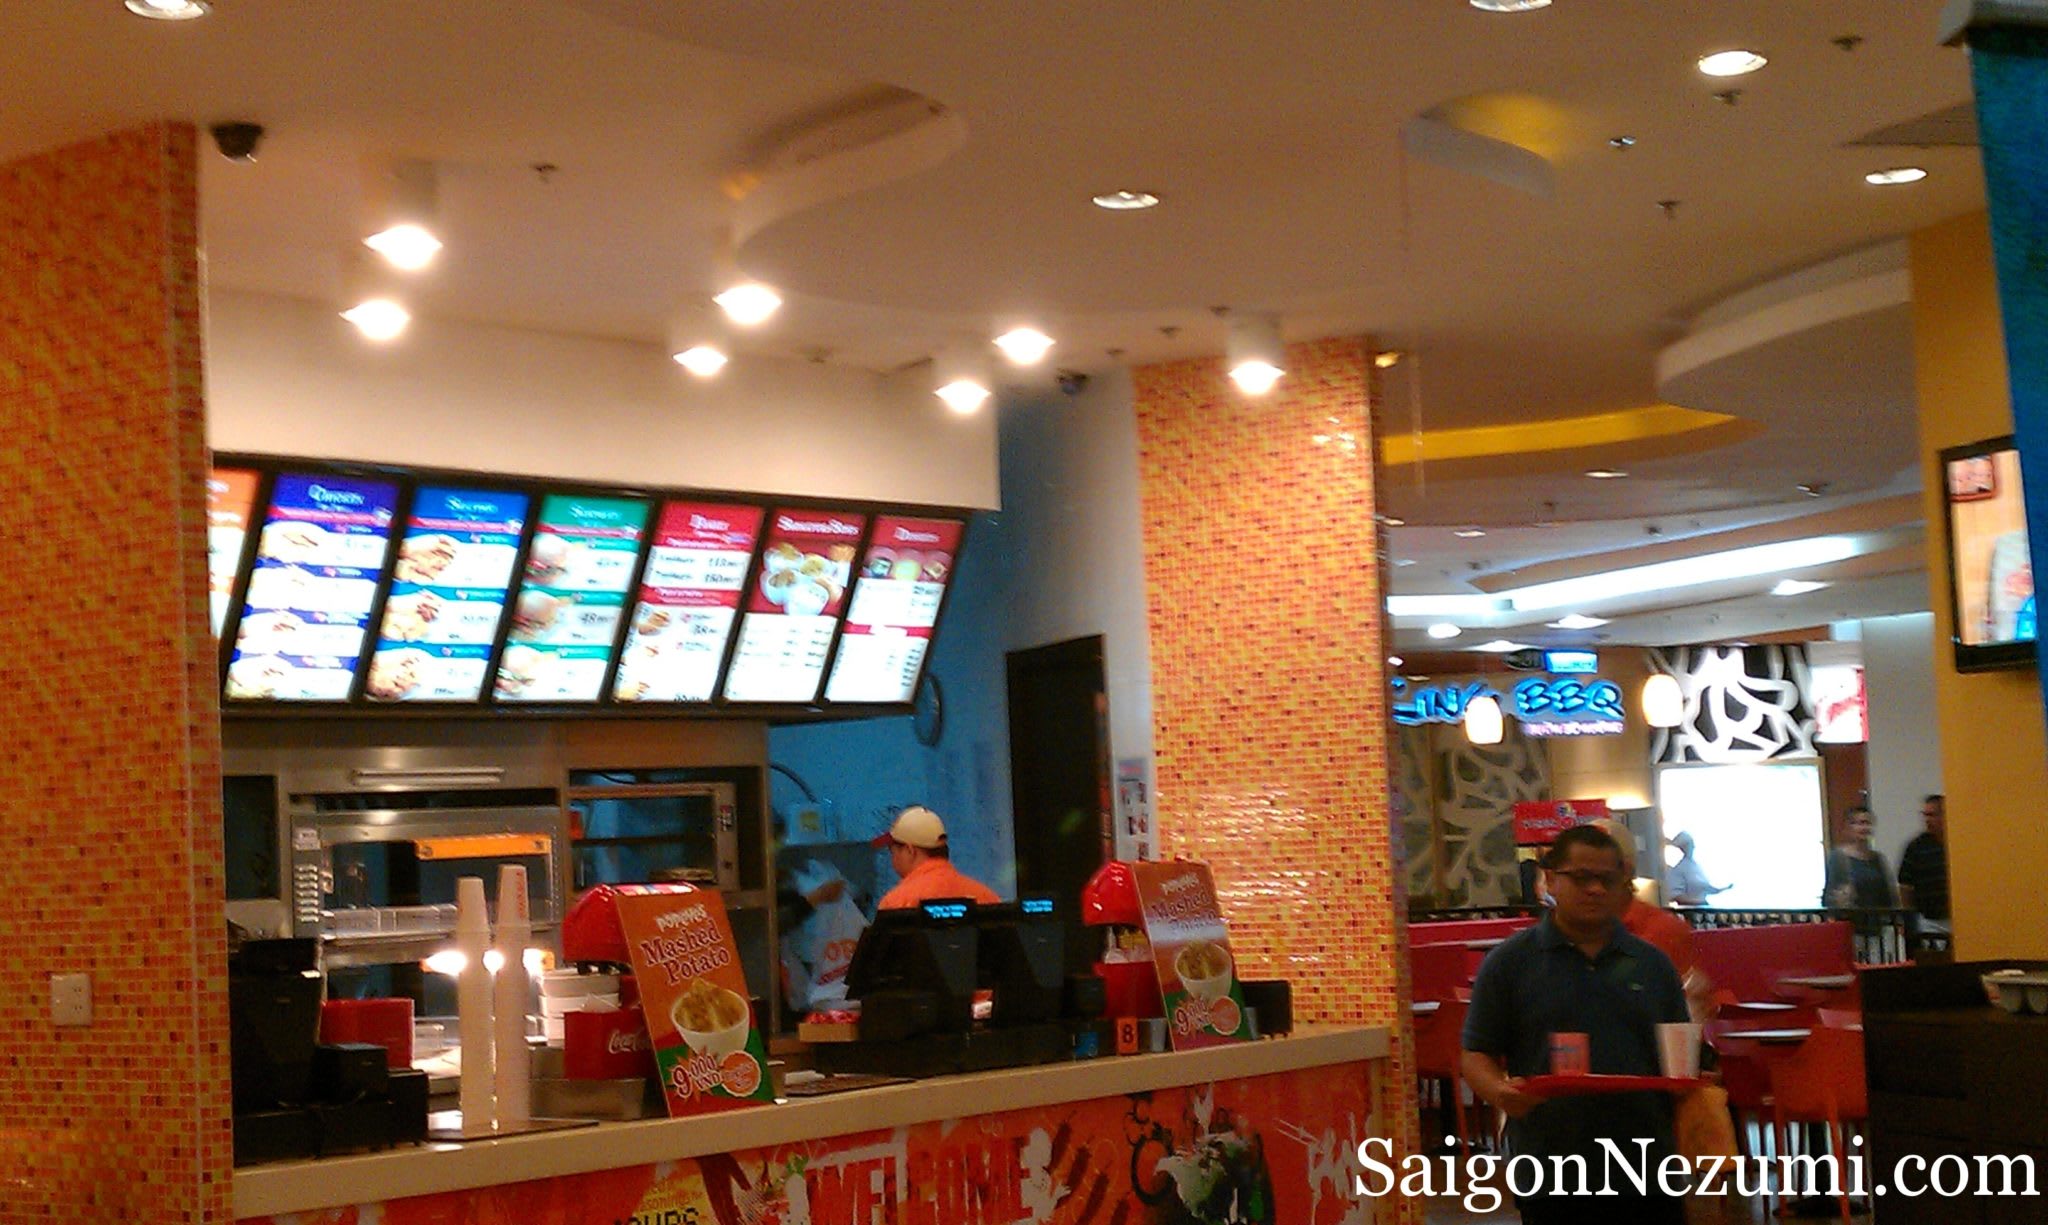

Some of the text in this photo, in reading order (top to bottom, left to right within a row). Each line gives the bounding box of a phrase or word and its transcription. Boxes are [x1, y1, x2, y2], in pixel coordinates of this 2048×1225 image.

[1513, 677, 1625, 719] BBQ
[640, 917, 723, 967] Mashed
[662, 946, 732, 986] Potato
[1121, 1023, 1135, 1040] 8
